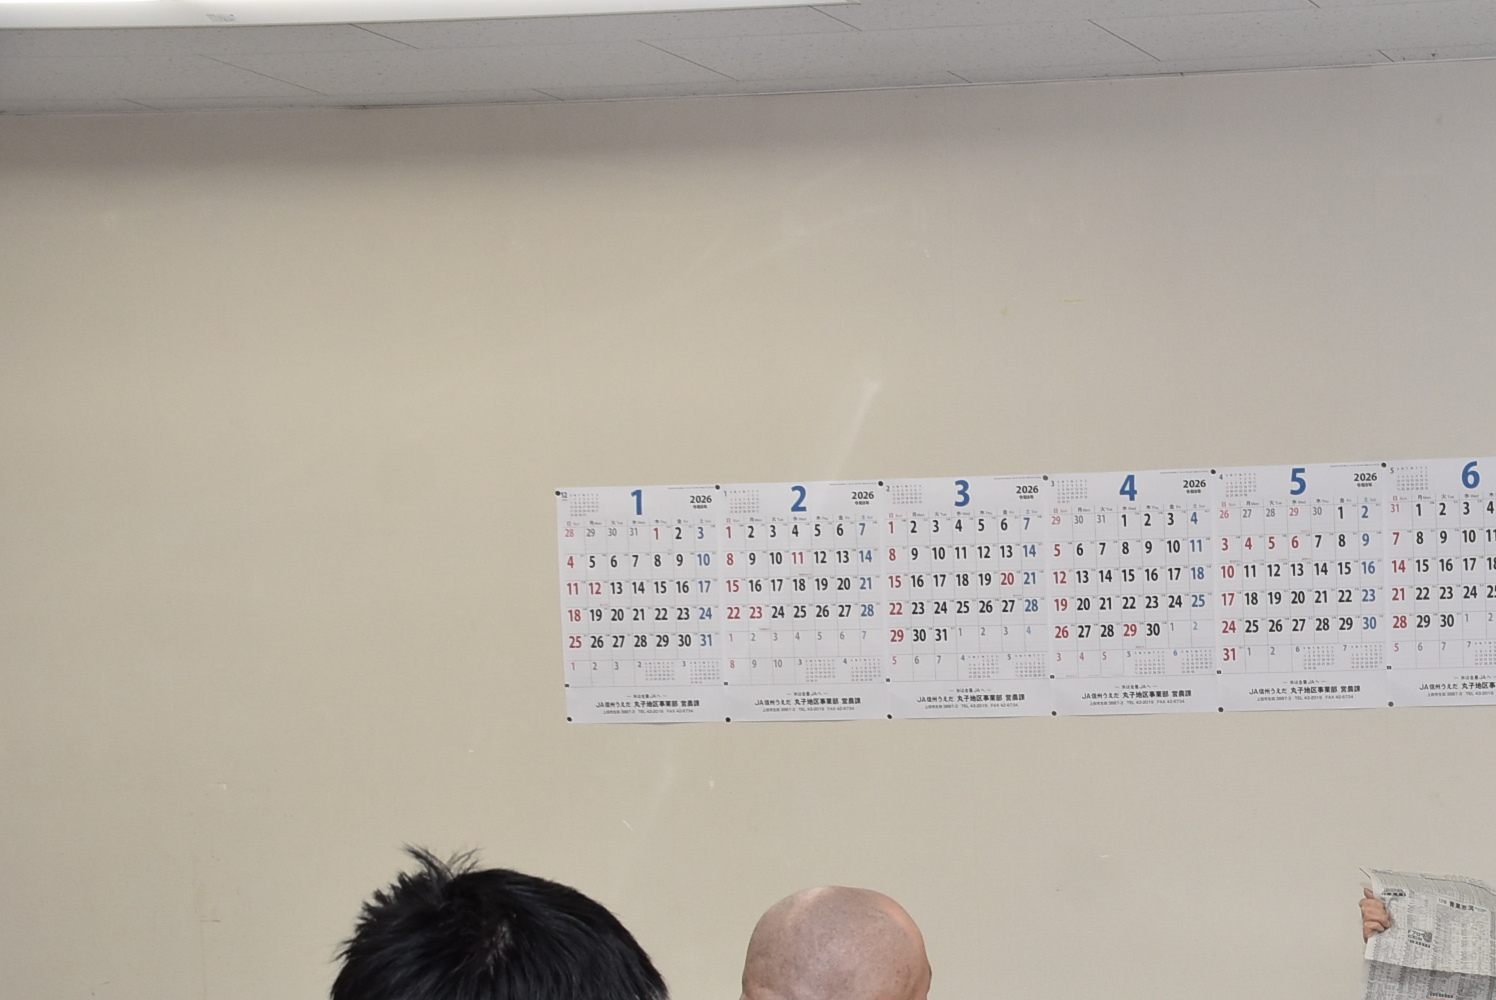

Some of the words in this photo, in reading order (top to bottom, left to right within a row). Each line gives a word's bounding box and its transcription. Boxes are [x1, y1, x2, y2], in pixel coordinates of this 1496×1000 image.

[1183, 479, 1206, 488] 2026
[1290, 468, 1306, 495] 5
[1354, 472, 1377, 482] 2026
[1462, 461, 1480, 489] 6
[852, 491, 874, 500] 2026
[954, 480, 970, 507] 3
[1016, 485, 1039, 494] 2026
[1119, 475, 1137, 501] 4
[631, 489, 642, 515] 1
[690, 495, 712, 504] 2026
[791, 486, 807, 512] 2
[889, 548, 896, 561] 8
[911, 547, 918, 560] 9
[932, 547, 945, 560] 10
[955, 546, 967, 559] 11
[977, 546, 991, 559] 12
[1000, 545, 1013, 558] 13
[1023, 544, 1036, 557] 14
[1221, 565, 1234, 578] 10
[1244, 565, 1256, 578] 11
[1267, 564, 1281, 577] 12
[1290, 563, 1304, 576] 13
[1314, 562, 1328, 576] 14
[1338, 562, 1351, 575] 15
[1361, 561, 1375, 574] 16
[568, 609, 581, 622] 18
[590, 609, 602, 621] 19
[611, 608, 624, 621] 20
[633, 608, 645, 621] 21
[655, 608, 668, 620] 22
[677, 607, 690, 620] 23
[699, 607, 712, 620] 24
